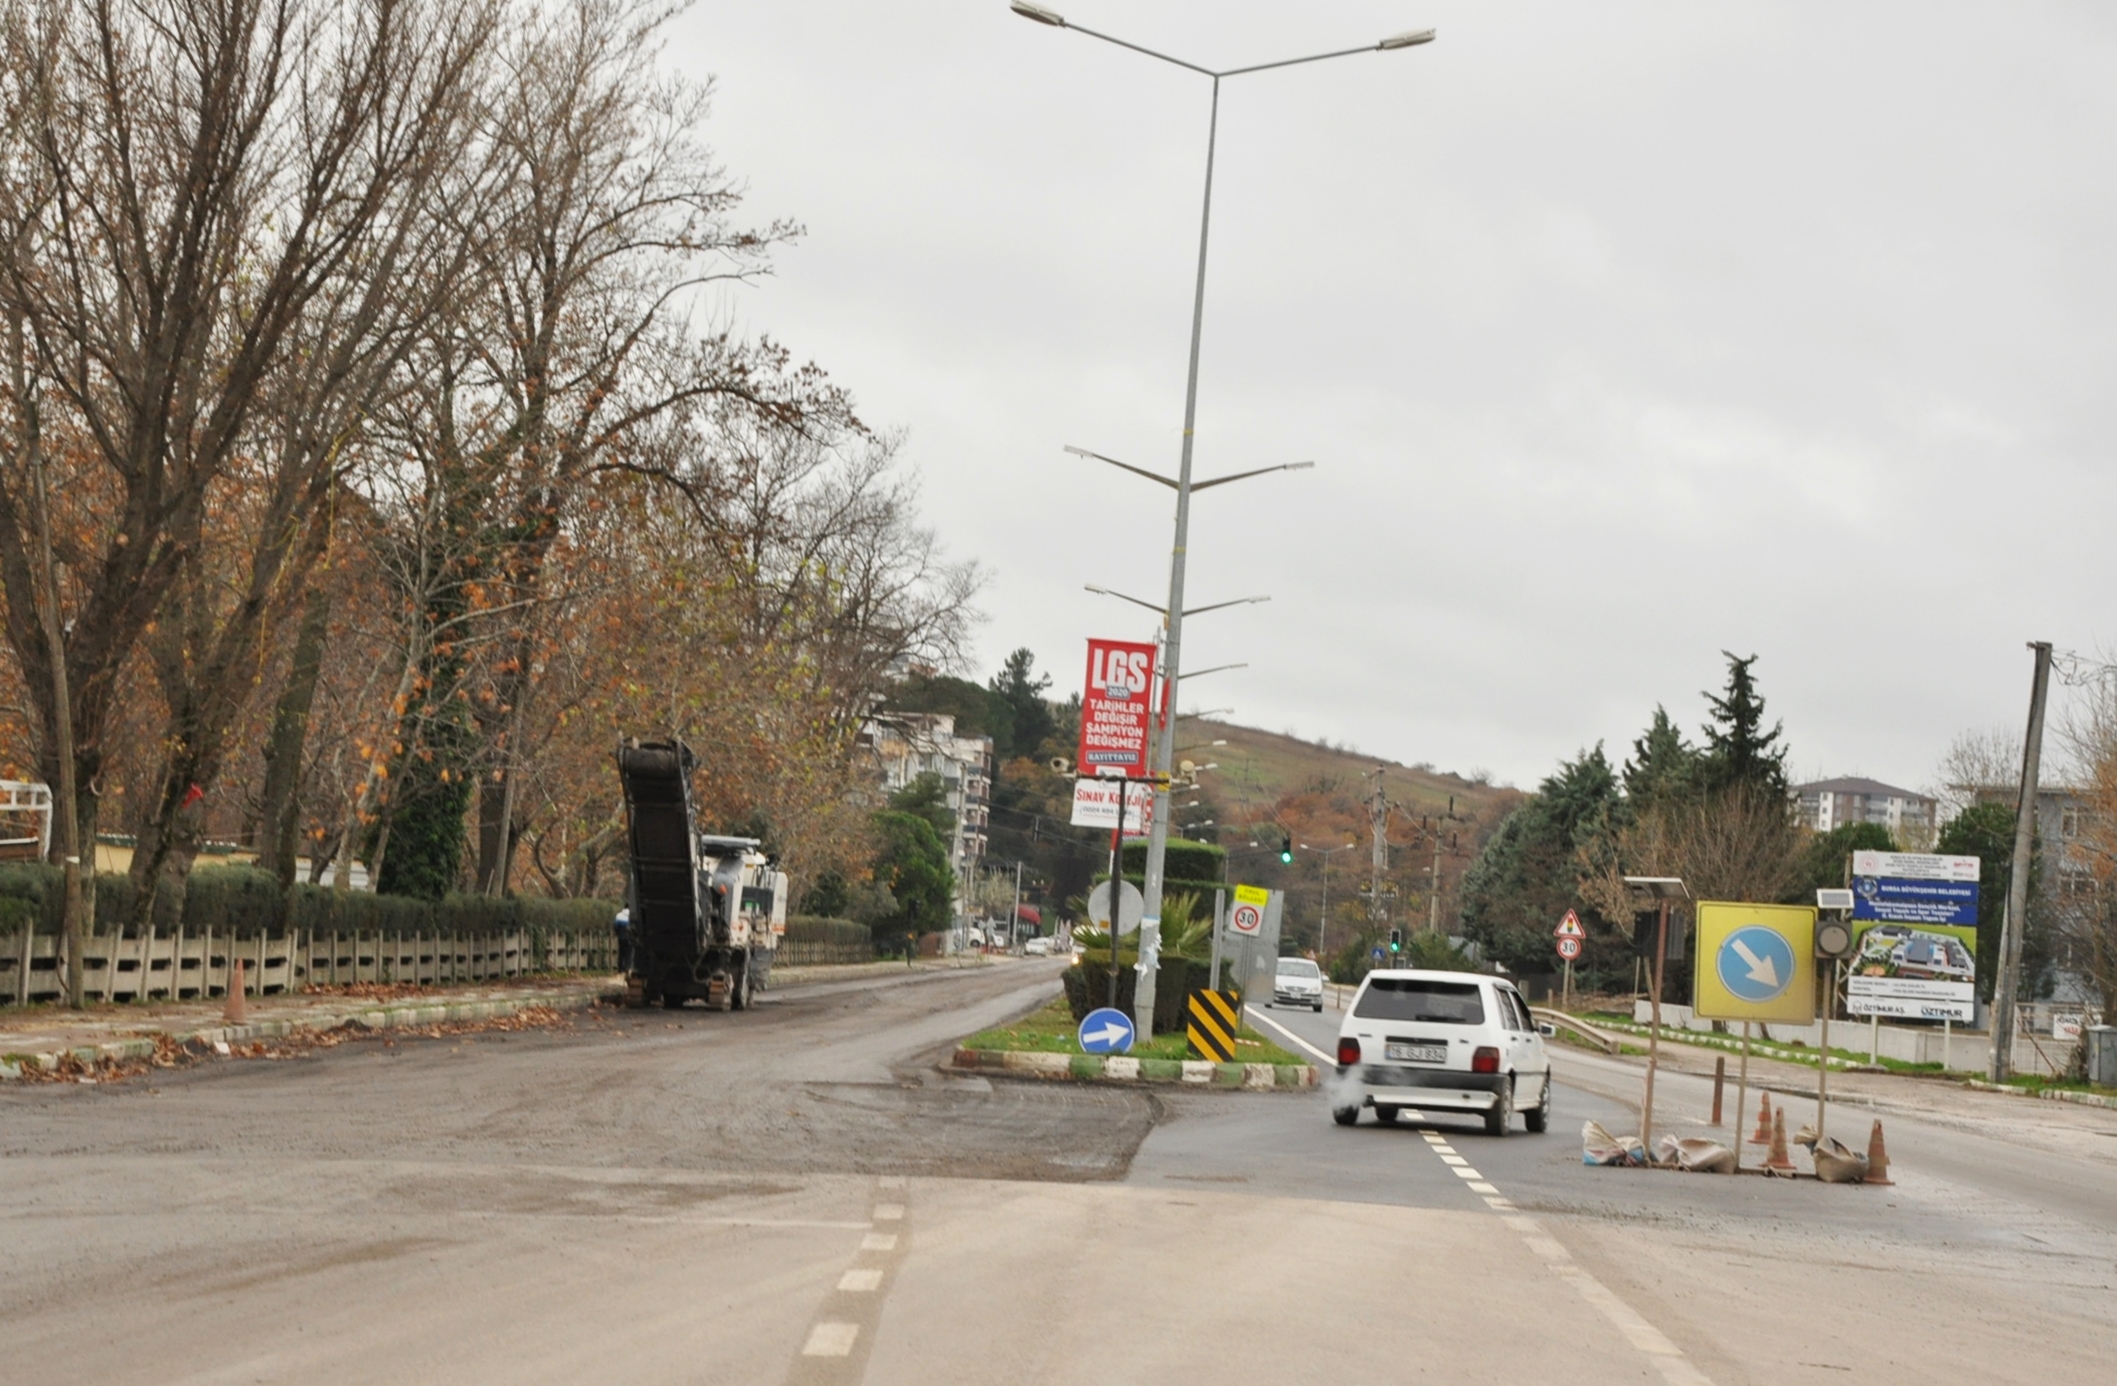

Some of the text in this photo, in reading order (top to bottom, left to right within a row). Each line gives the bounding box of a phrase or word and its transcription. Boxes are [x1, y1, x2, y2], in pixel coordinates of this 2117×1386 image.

[1092, 648, 1148, 693] LGS
[1107, 686, 1129, 698] 2020
[1089, 698, 1144, 714] TARİHLER
[1094, 710, 1138, 725] DEĞİŞİR
[1086, 721, 1142, 737] ŞAMPİYON
[1086, 733, 1141, 749] DEĞİŞMEZ
[1076, 788, 1142, 807] SINAV KOEJİ
[1901, 886, 1937, 894] BÜYÜKŞEHİR
[1938, 888, 1971, 896] BELEDİYESİ
[1239, 912, 1254, 924] 30
[1563, 942, 1576, 953] 30
